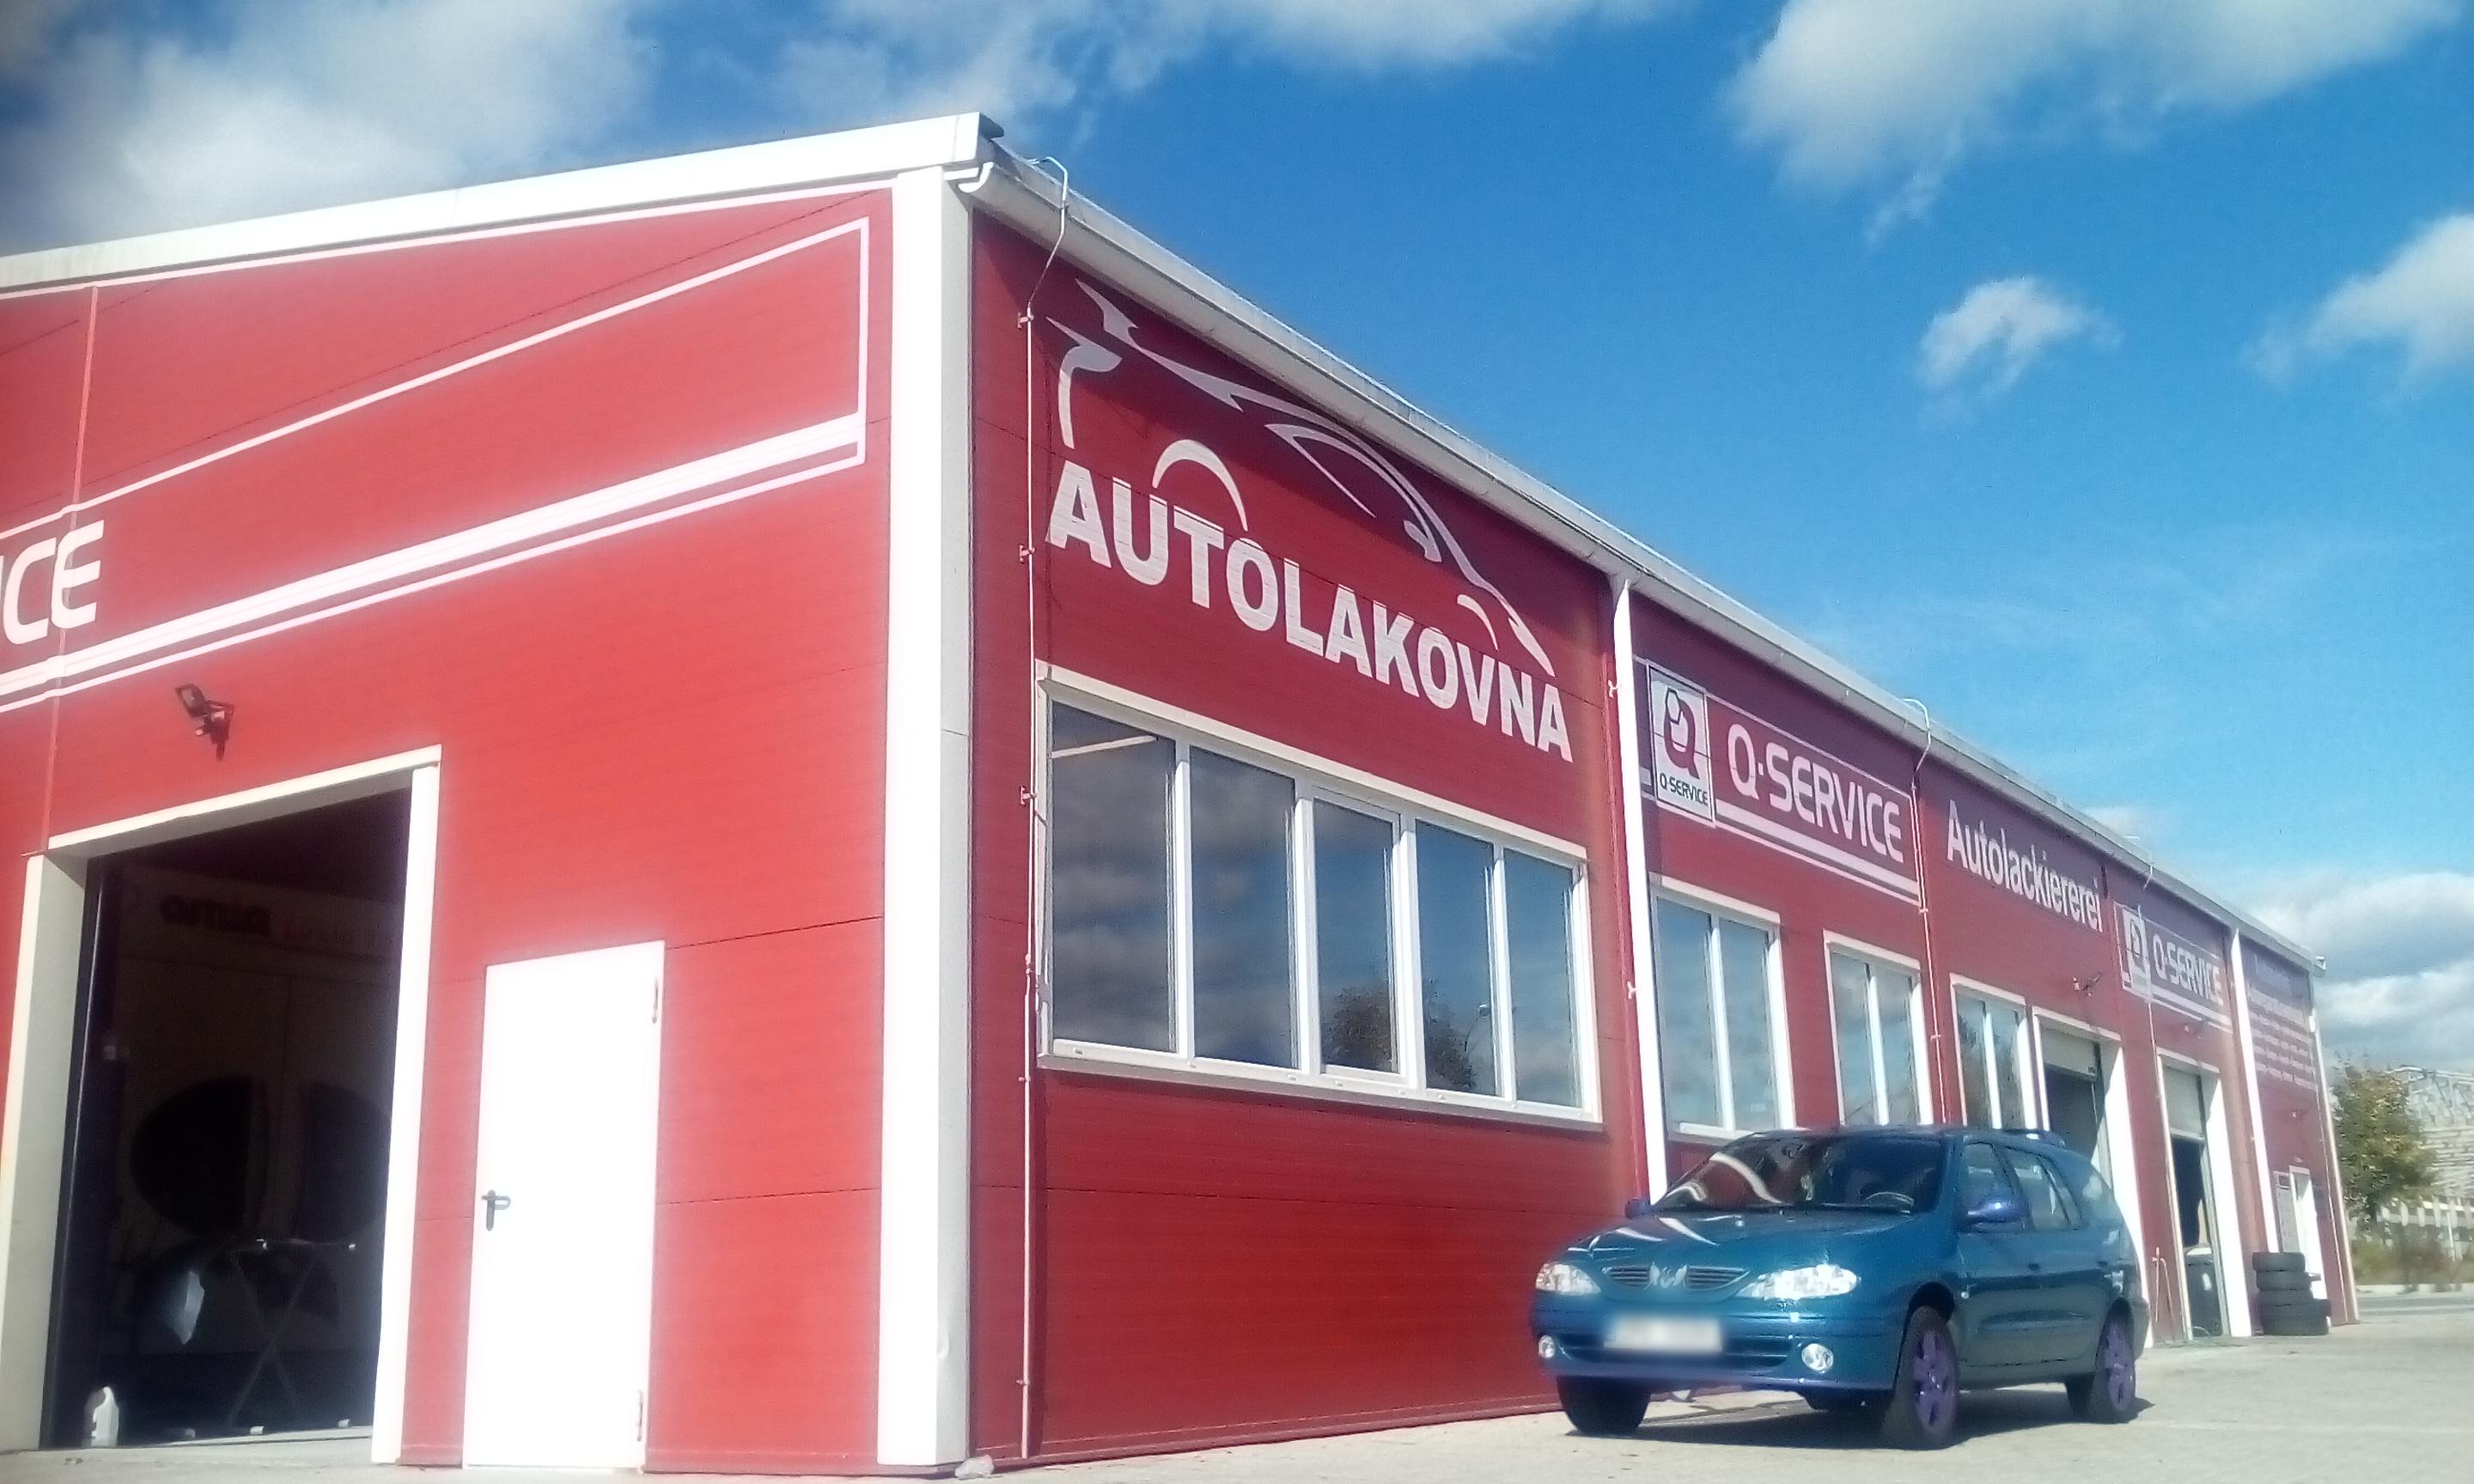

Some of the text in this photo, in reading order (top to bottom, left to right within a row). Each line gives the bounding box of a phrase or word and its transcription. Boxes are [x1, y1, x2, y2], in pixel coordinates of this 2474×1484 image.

[0, 520, 105, 645] CE
[1045, 459, 1574, 763] AUTOLAKOVNA
[1947, 799, 2104, 933] Autolackiererei
